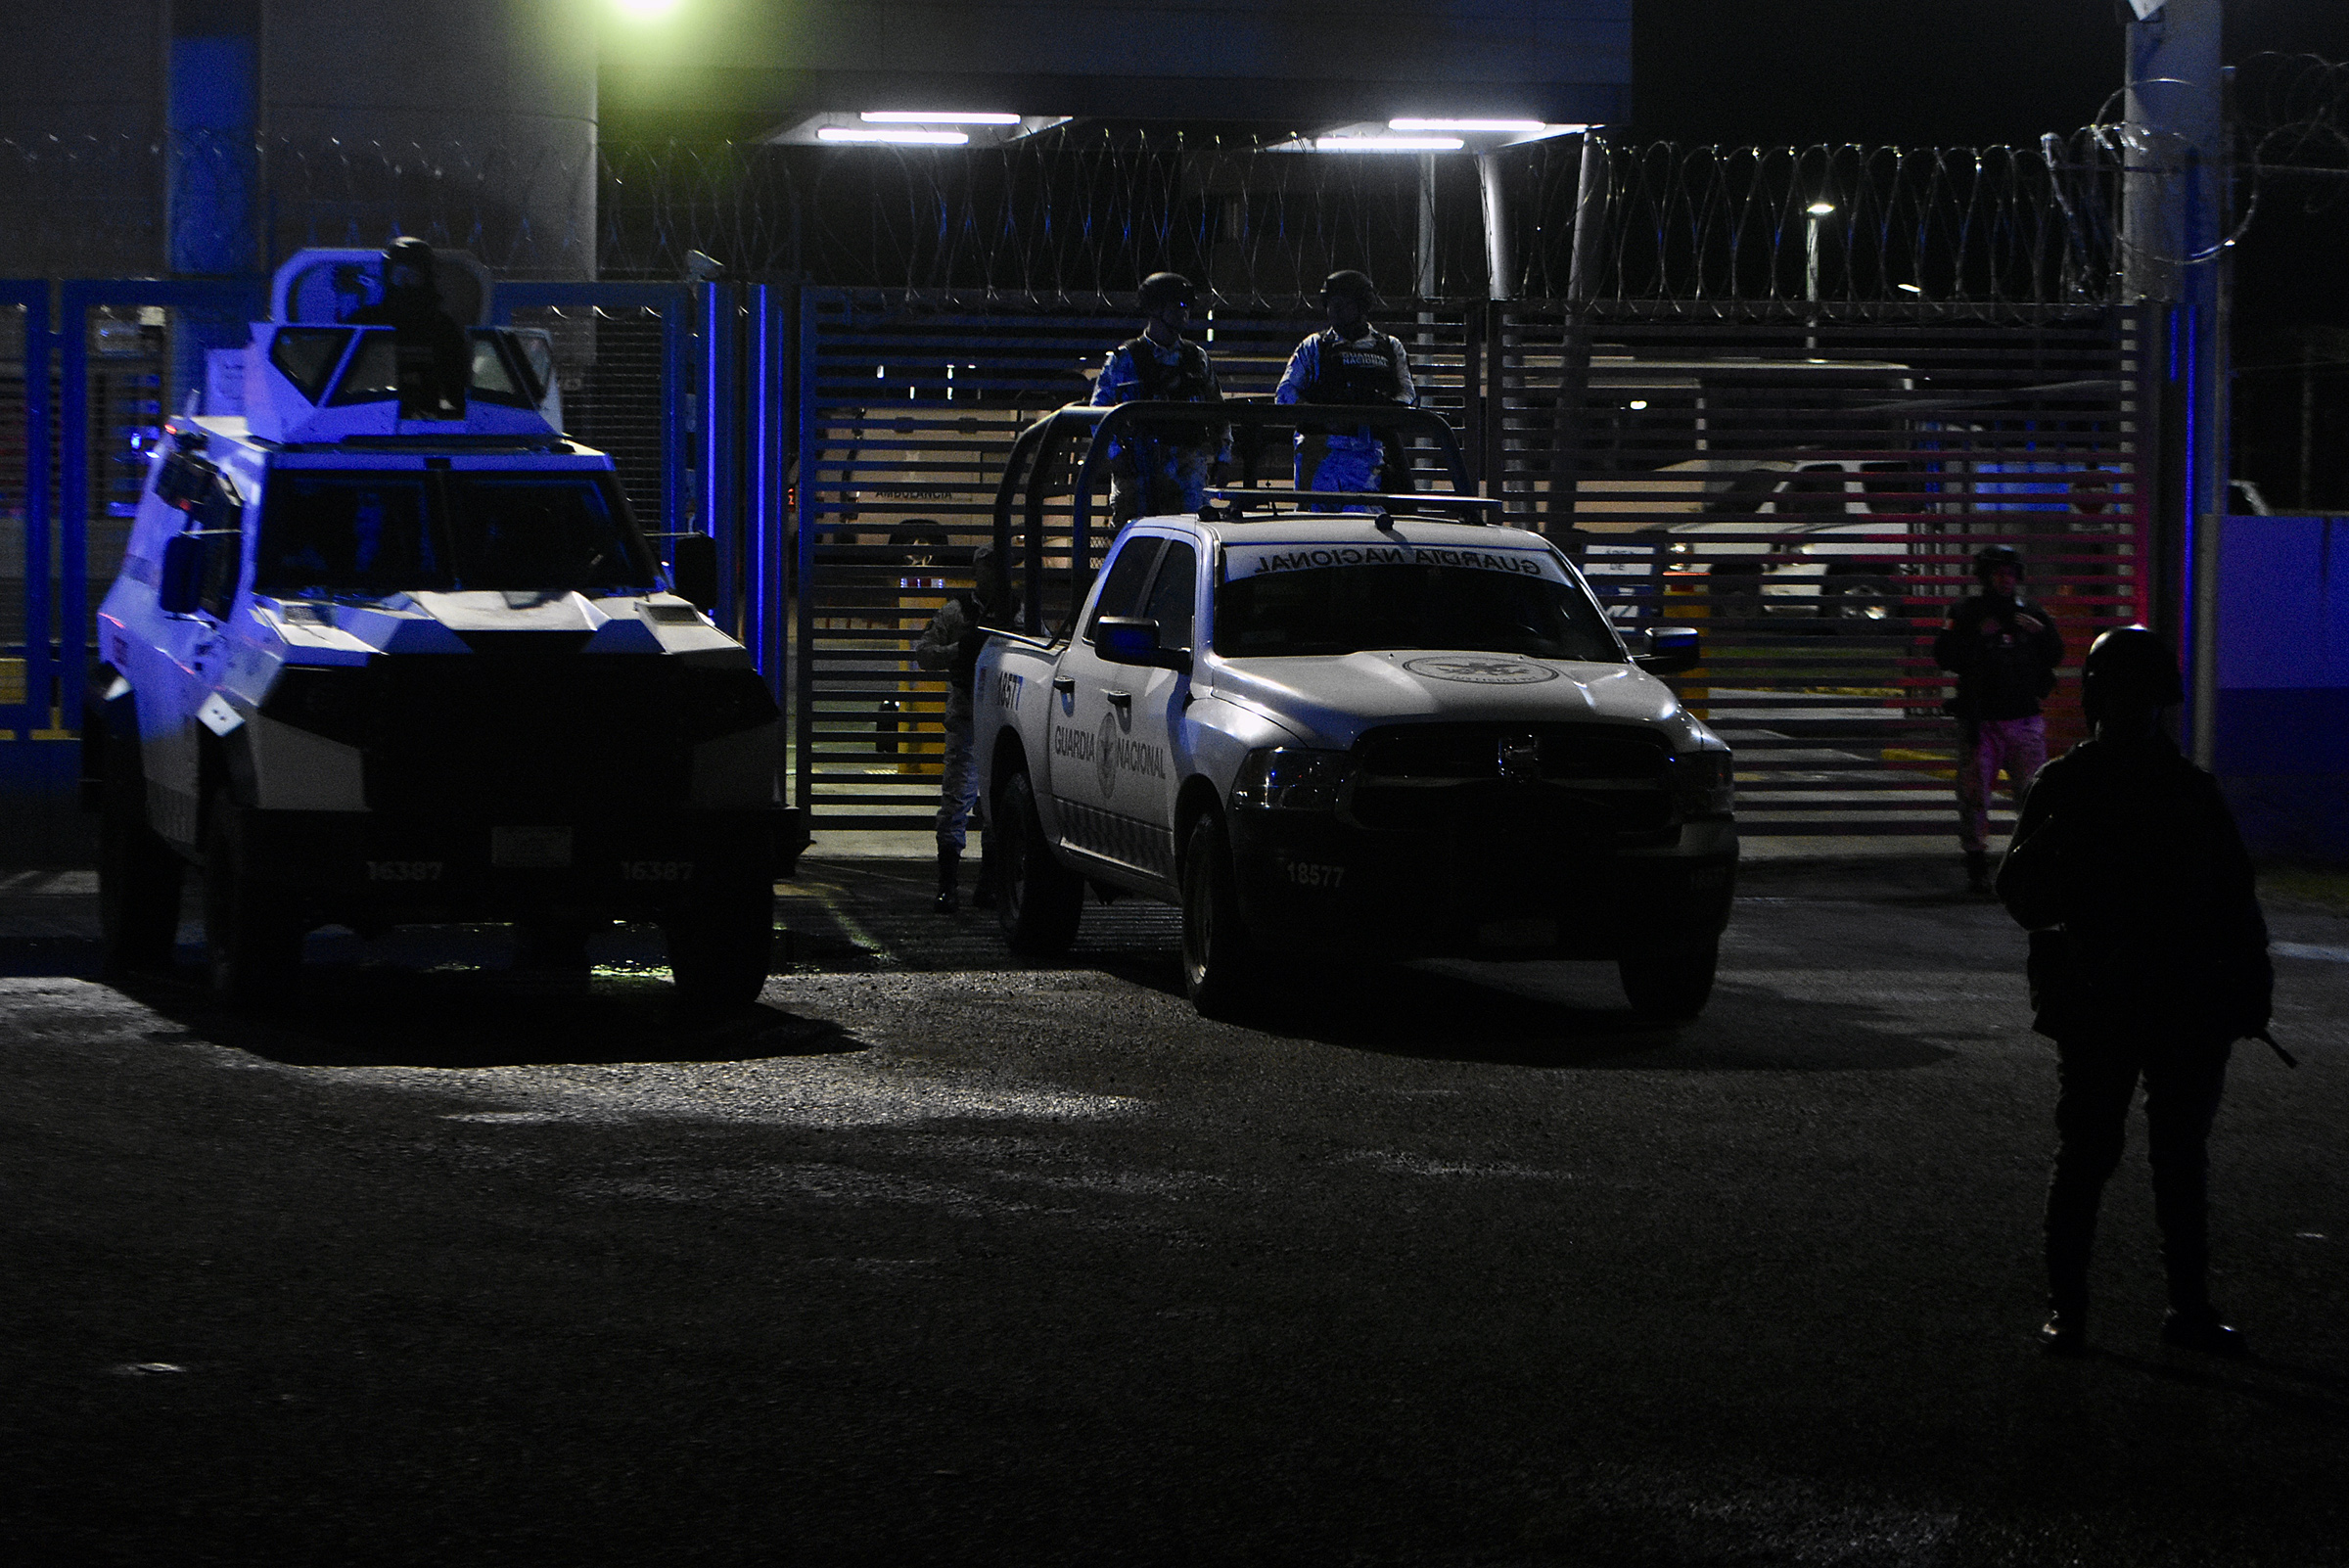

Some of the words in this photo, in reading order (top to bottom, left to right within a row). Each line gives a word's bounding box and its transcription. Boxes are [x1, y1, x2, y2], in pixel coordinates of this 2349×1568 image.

[1343, 358, 1389, 367] NACIONAL
[997, 671, 1024, 711] 18577
[1055, 725, 1095, 762] GUARDIA
[1118, 738, 1166, 779] NACIONAL
[366, 860, 443, 881] 16387
[620, 860, 694, 881] 16387
[1286, 860, 1346, 888] 18577
